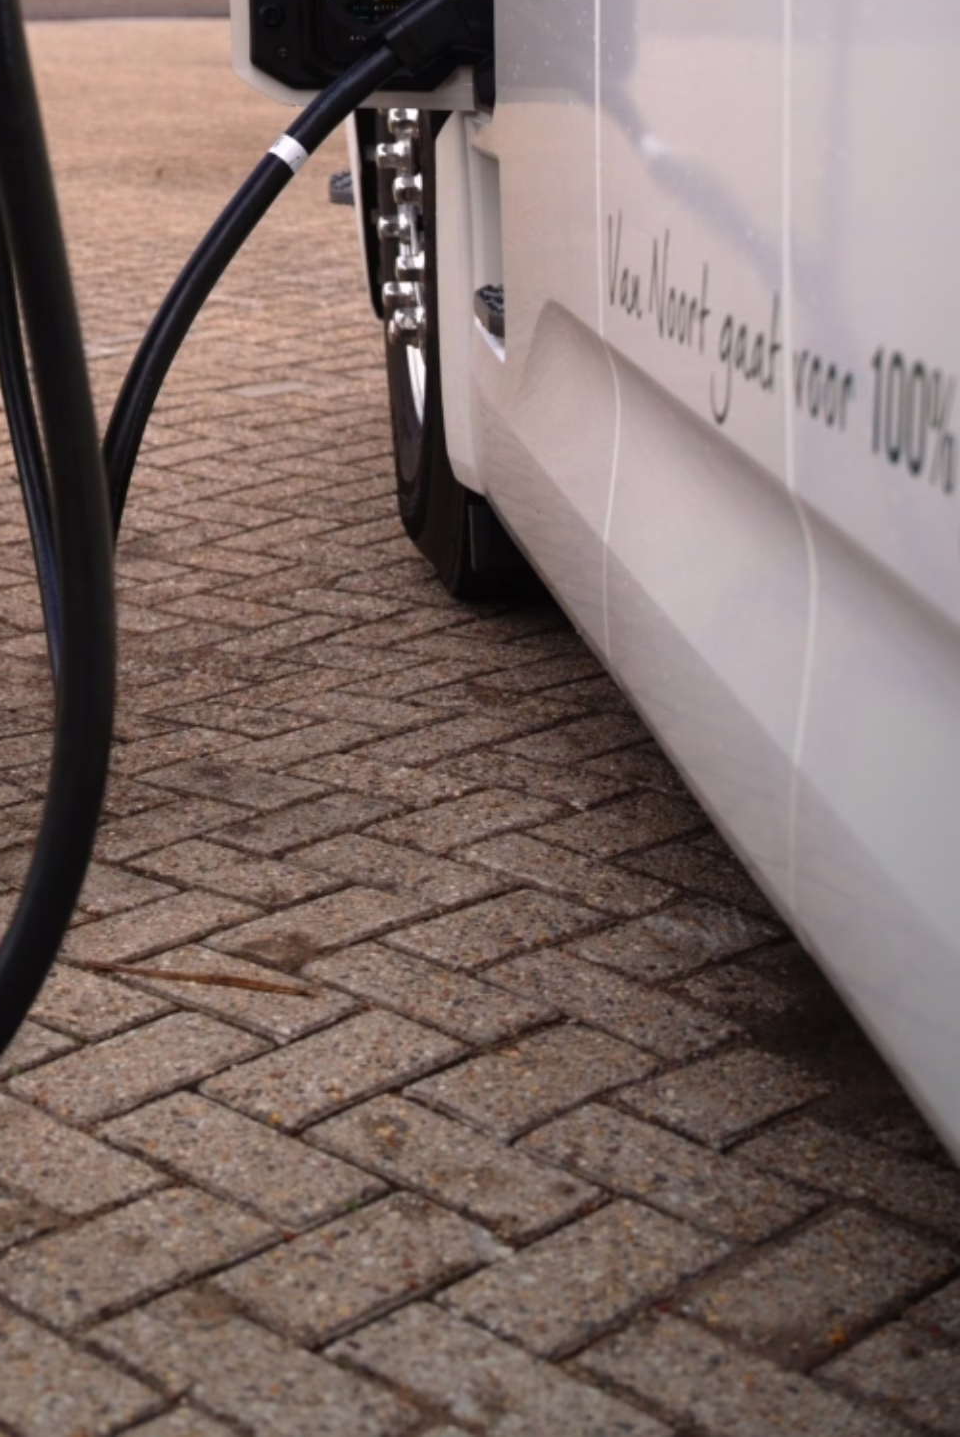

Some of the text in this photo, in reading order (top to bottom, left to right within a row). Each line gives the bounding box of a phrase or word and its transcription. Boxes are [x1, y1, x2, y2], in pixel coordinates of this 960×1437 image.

[607, 209, 957, 494] Van Noort gaat voor 100%
